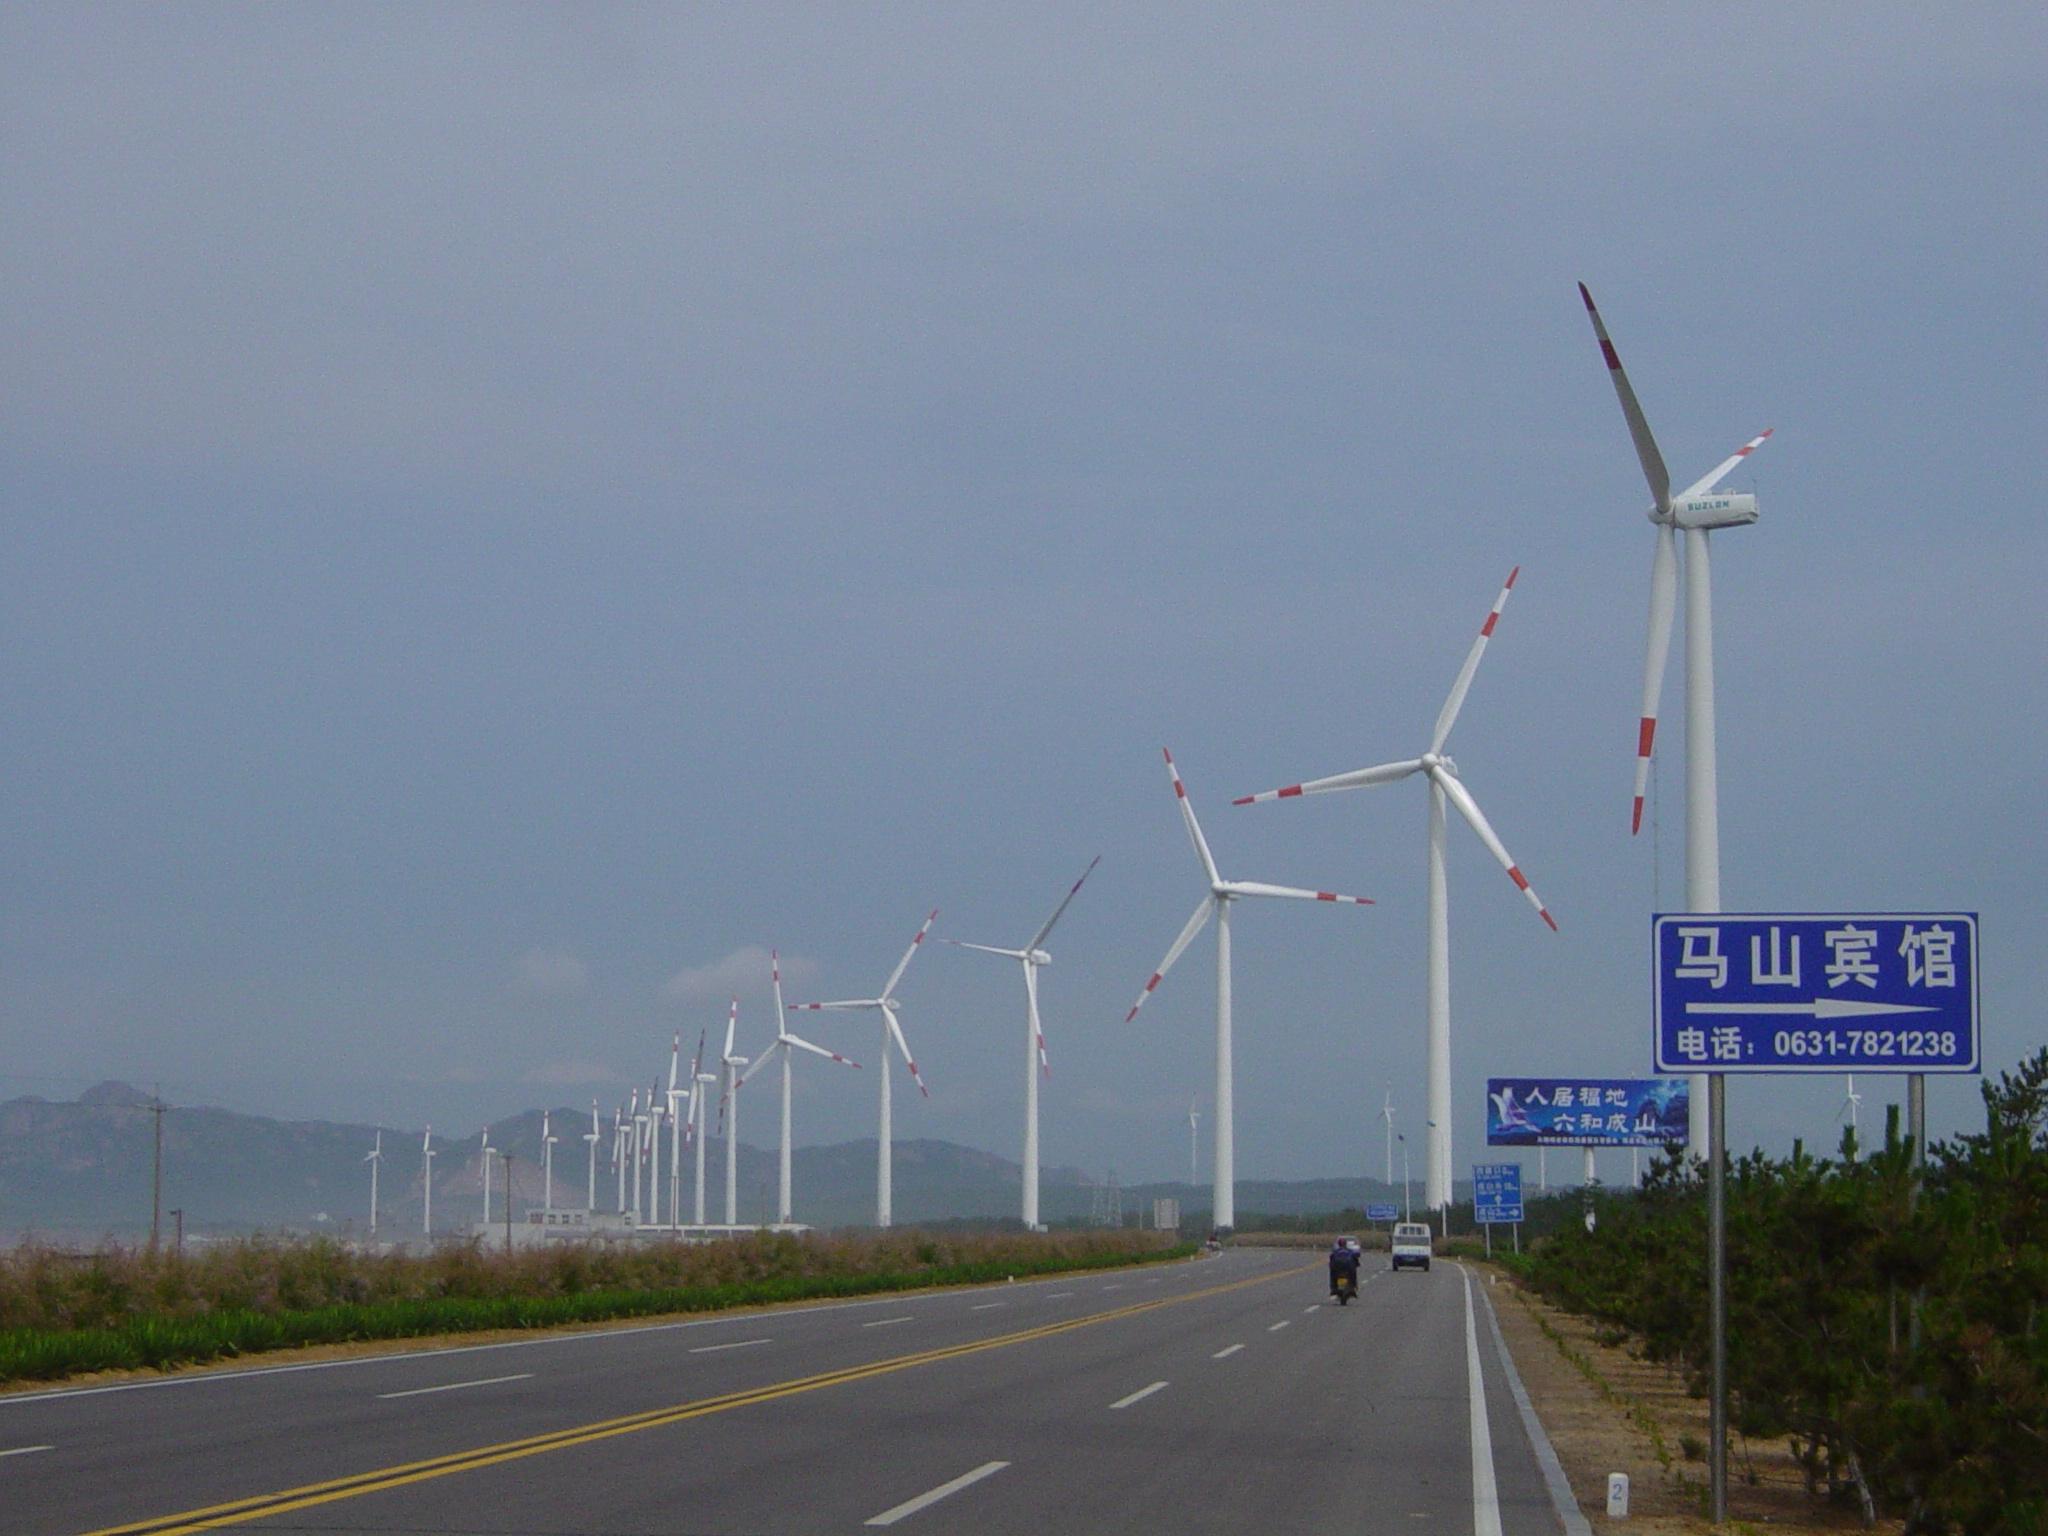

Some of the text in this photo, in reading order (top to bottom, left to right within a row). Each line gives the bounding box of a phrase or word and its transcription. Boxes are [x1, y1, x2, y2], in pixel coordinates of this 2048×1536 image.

[1675, 923, 1956, 989] 马山宾馆
[1774, 1030, 1957, 1057] 0631-7821238
[1524, 1086, 1629, 1107] 人居福地
[1553, 1113, 1656, 1133] 六和成山
[1612, 1483, 1622, 1501] 2
